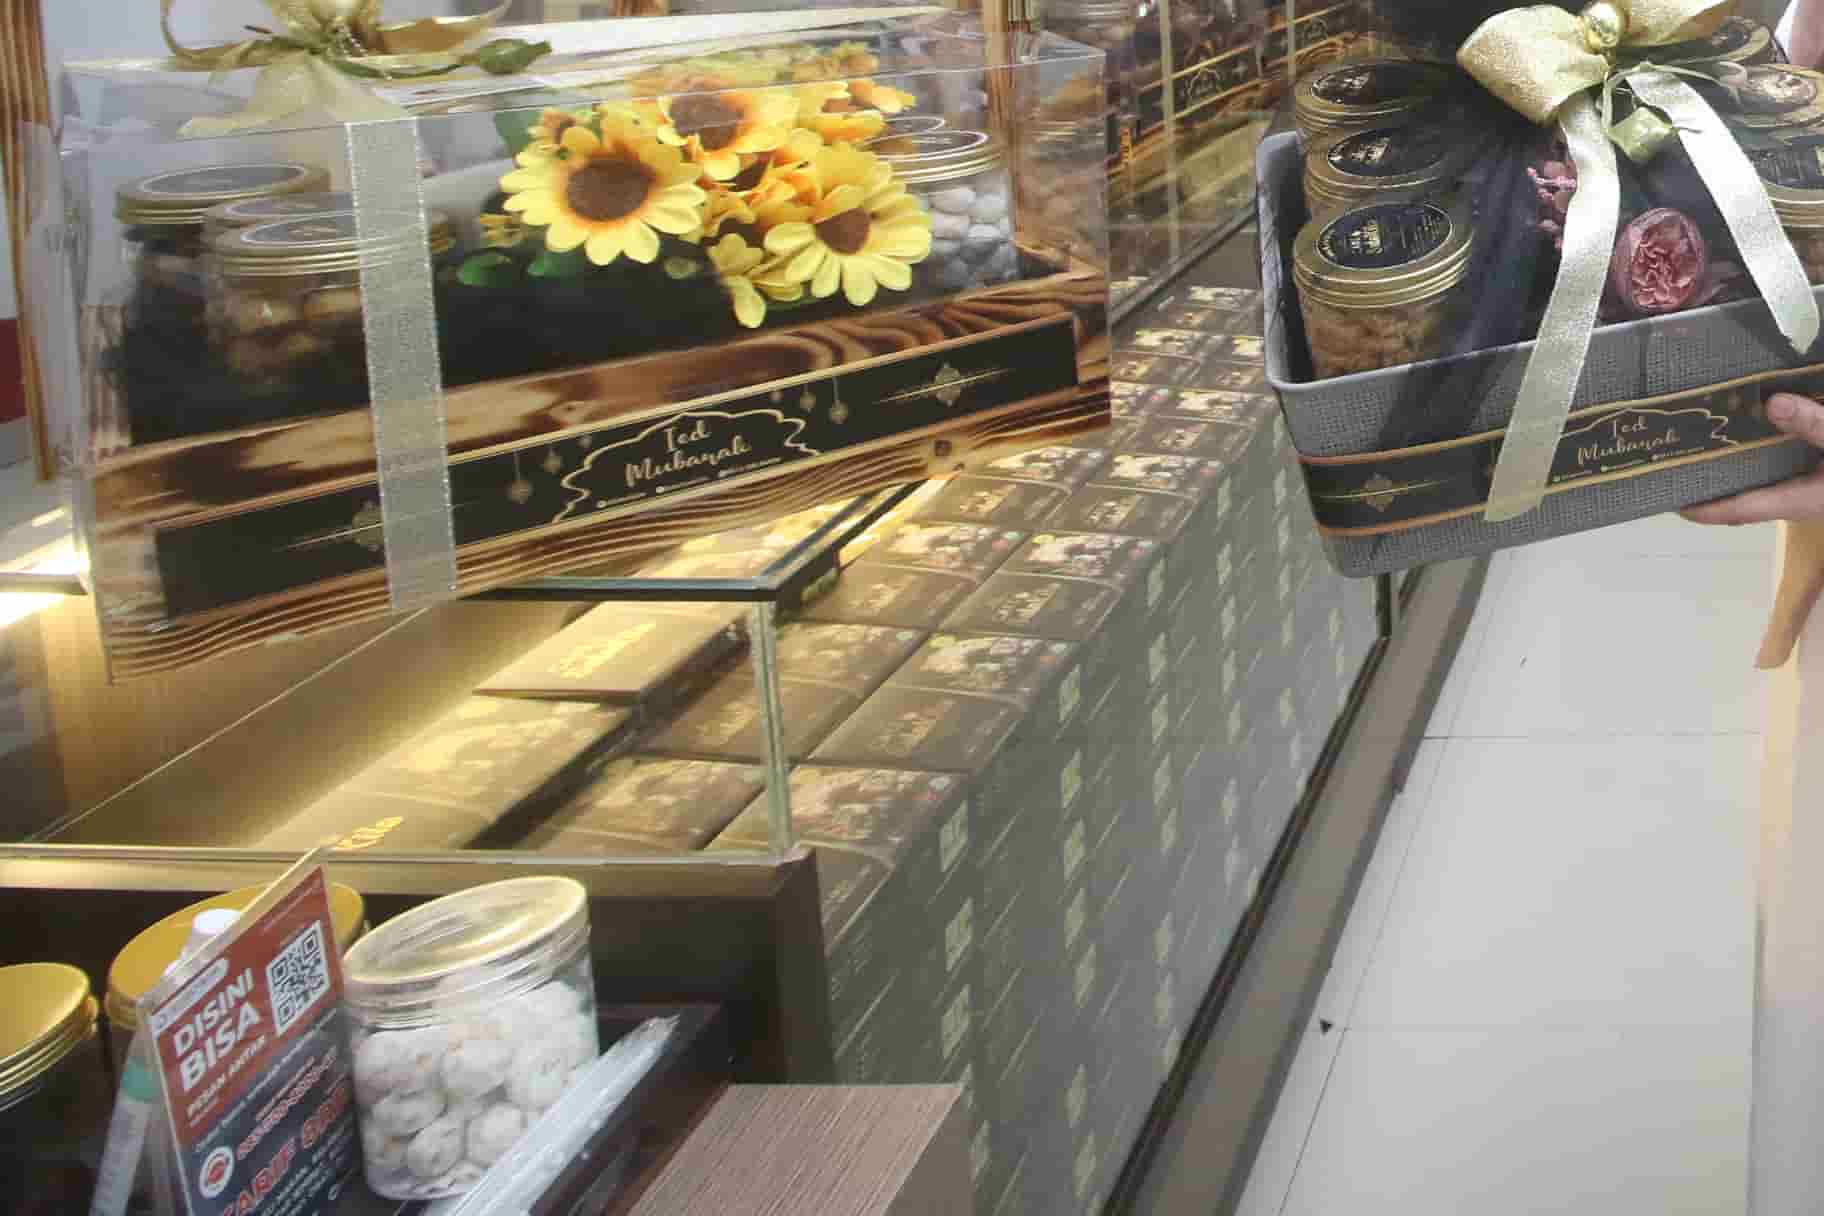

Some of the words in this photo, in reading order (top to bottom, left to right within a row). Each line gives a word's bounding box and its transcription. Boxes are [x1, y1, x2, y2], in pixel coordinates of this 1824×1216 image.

[624, 435, 752, 488] Mubarak
[173, 968, 255, 1057] DISINI
[179, 1001, 262, 1093] BISA
